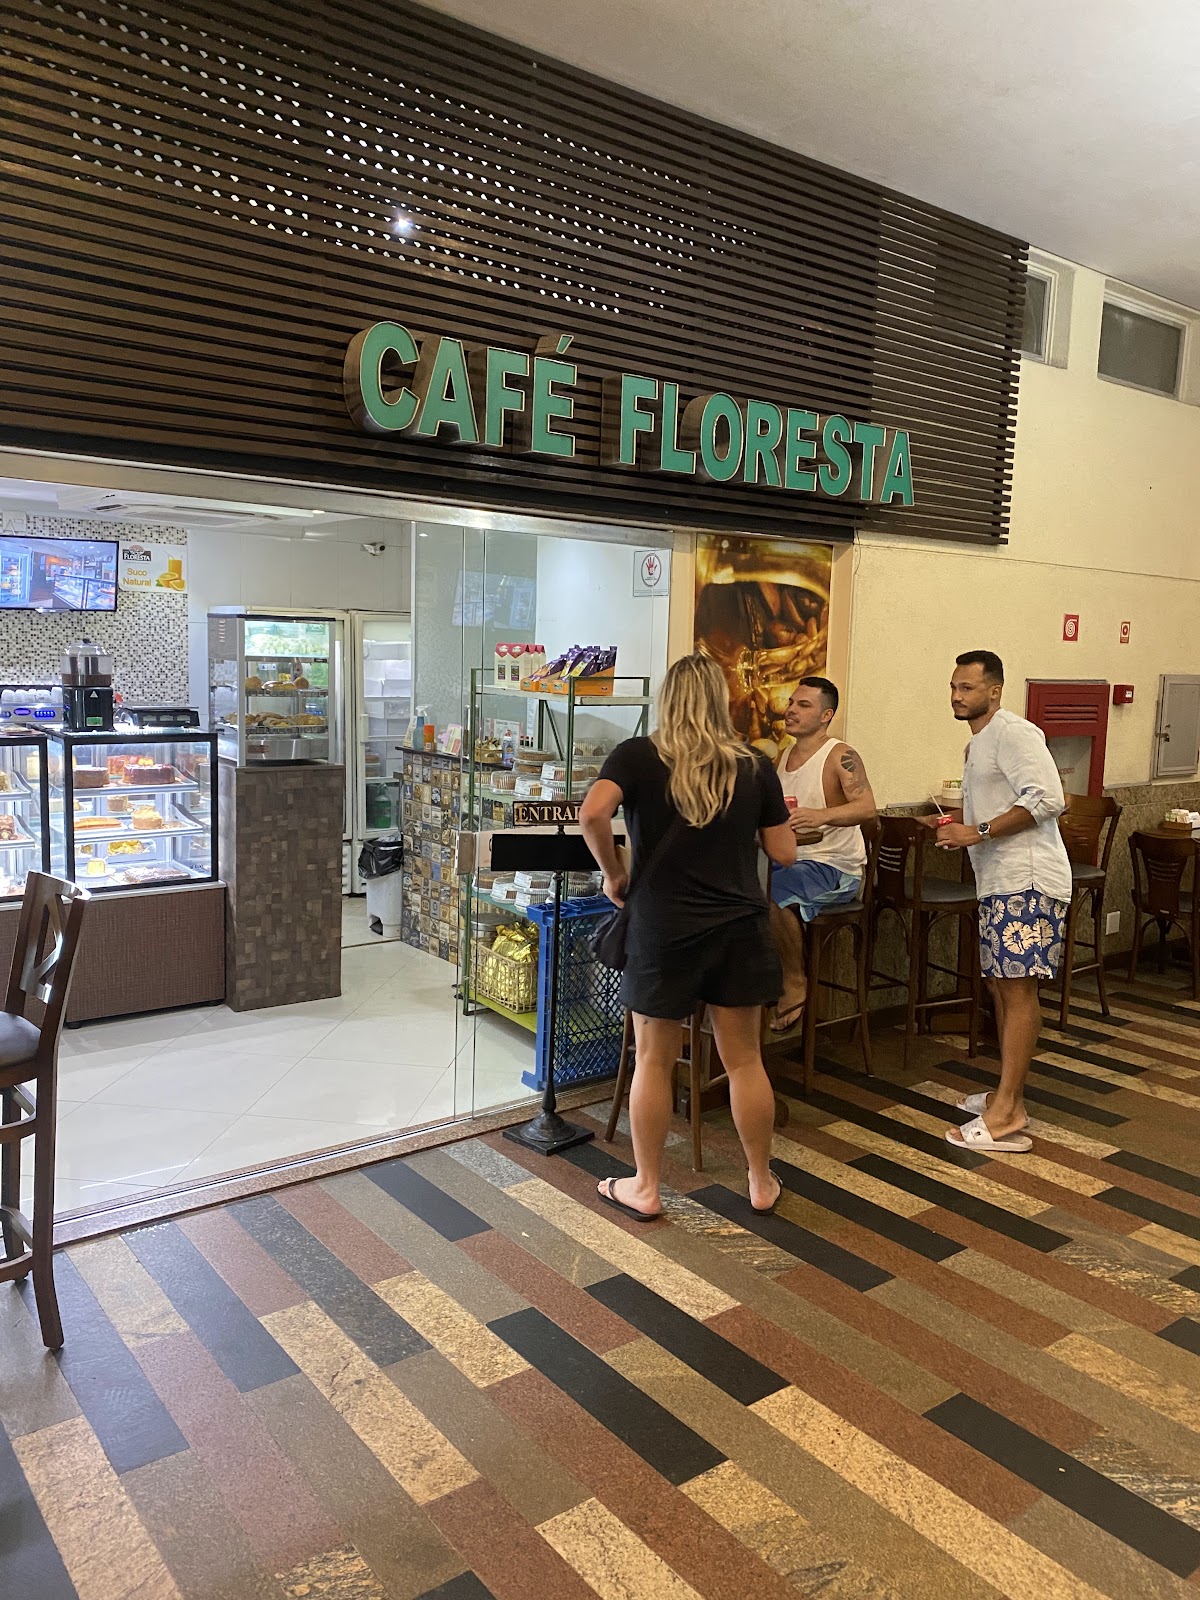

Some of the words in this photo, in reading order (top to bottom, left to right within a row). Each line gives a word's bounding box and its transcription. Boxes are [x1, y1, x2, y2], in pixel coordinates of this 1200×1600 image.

[359, 320, 578, 458] CAFÉ
[620, 373, 915, 507] FLORESTA
[124, 553, 150, 561] FLORESTA
[127, 568, 147, 576] Suco
[123, 578, 151, 586] Natural
[518, 805, 580, 821] ENTRA
